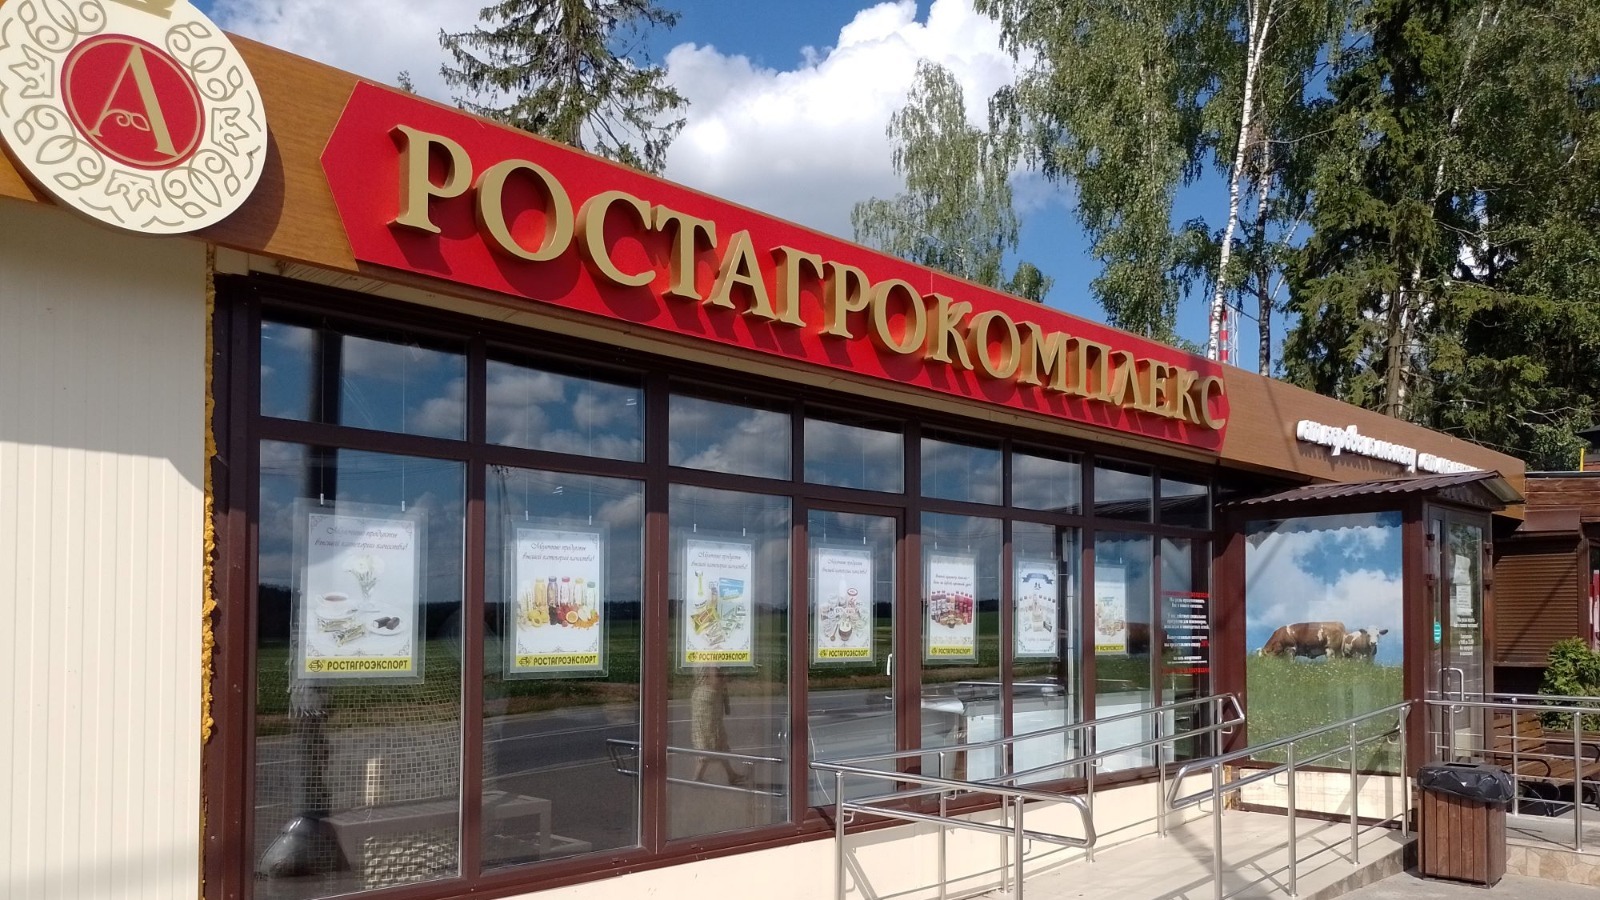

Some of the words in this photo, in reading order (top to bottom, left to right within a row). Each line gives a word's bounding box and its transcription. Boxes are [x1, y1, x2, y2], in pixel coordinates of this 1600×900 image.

[387, 124, 1226, 430] РОСТАГРОКОМПЛЕКС
[326, 659, 408, 670] РОСТАГРОЭКСПОРТ
[533, 655, 597, 666] РОСТАГРОЭКСПОРТ
